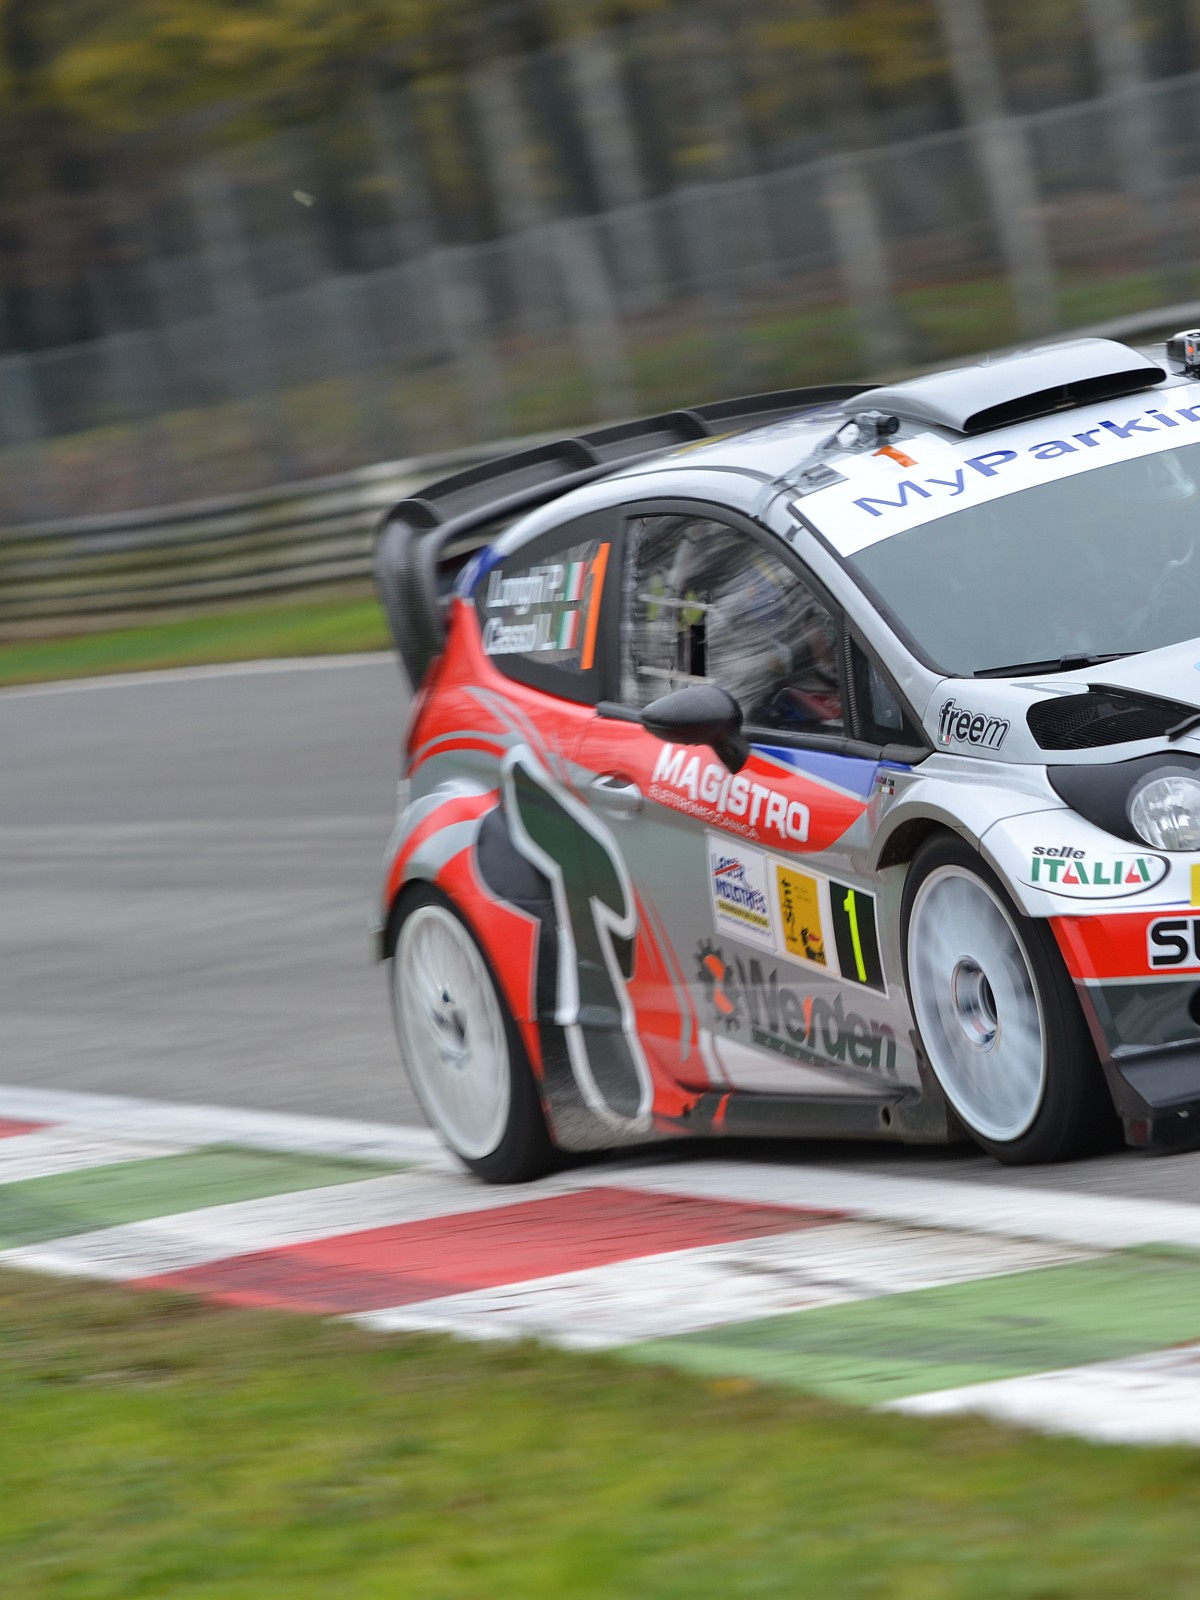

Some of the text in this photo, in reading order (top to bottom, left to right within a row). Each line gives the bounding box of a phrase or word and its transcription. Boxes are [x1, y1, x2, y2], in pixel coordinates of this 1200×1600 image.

[580, 542, 611, 670] 1
[938, 700, 1009, 748] freem
[650, 743, 811, 843] MAGISTRO
[1031, 856, 1152, 885] ITALIA
[1032, 845, 1086, 860] selle
[842, 889, 868, 984] 1
[734, 952, 901, 1071] Werden
